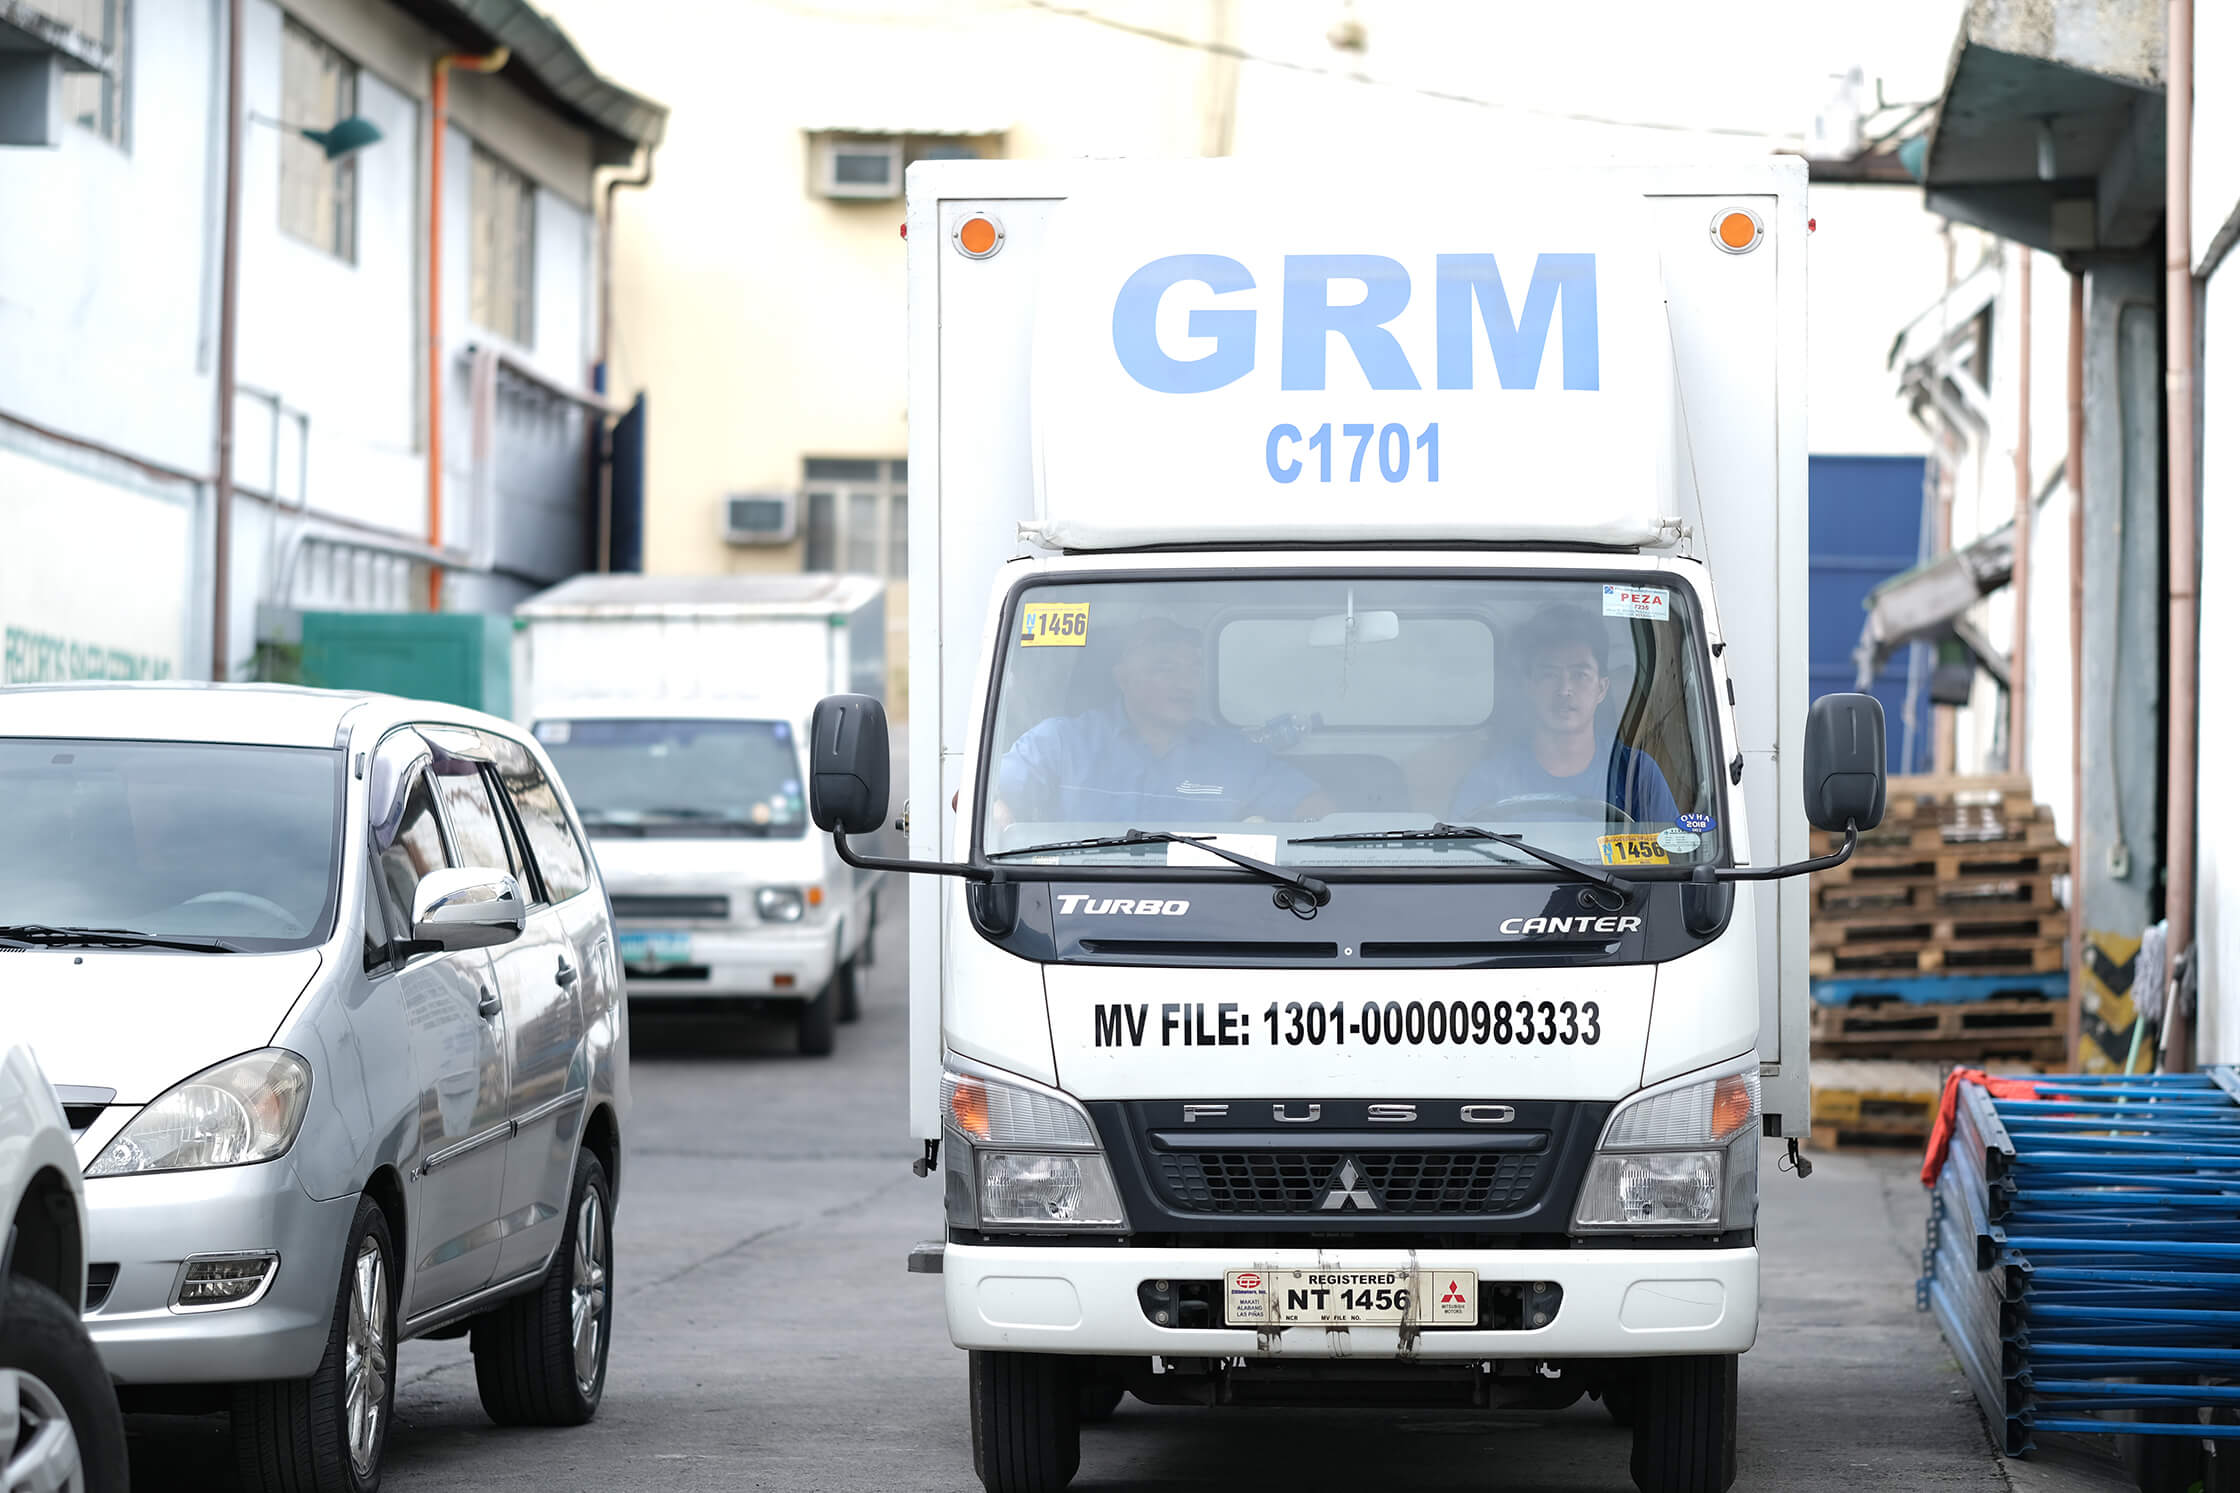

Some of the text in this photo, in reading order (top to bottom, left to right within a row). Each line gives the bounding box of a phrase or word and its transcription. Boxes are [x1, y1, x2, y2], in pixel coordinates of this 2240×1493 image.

[1111, 252, 1600, 394] GRM
[1265, 421, 1440, 484] C1701
[1621, 593, 1662, 605] PEZA
[1038, 613, 1087, 636] 1456
[1680, 813, 1710, 822] OVHA
[1615, 841, 1665, 861] 1456
[1057, 894, 1190, 916] TURBO
[1499, 916, 1642, 934] CANTER
[1093, 1000, 1601, 1047] MV FILE: 1301-00000983333
[1183, 1103, 1517, 1123] FUSO
[1308, 1274, 1396, 1285] REGISTERED
[1287, 1288, 1411, 1310] NT 1456
